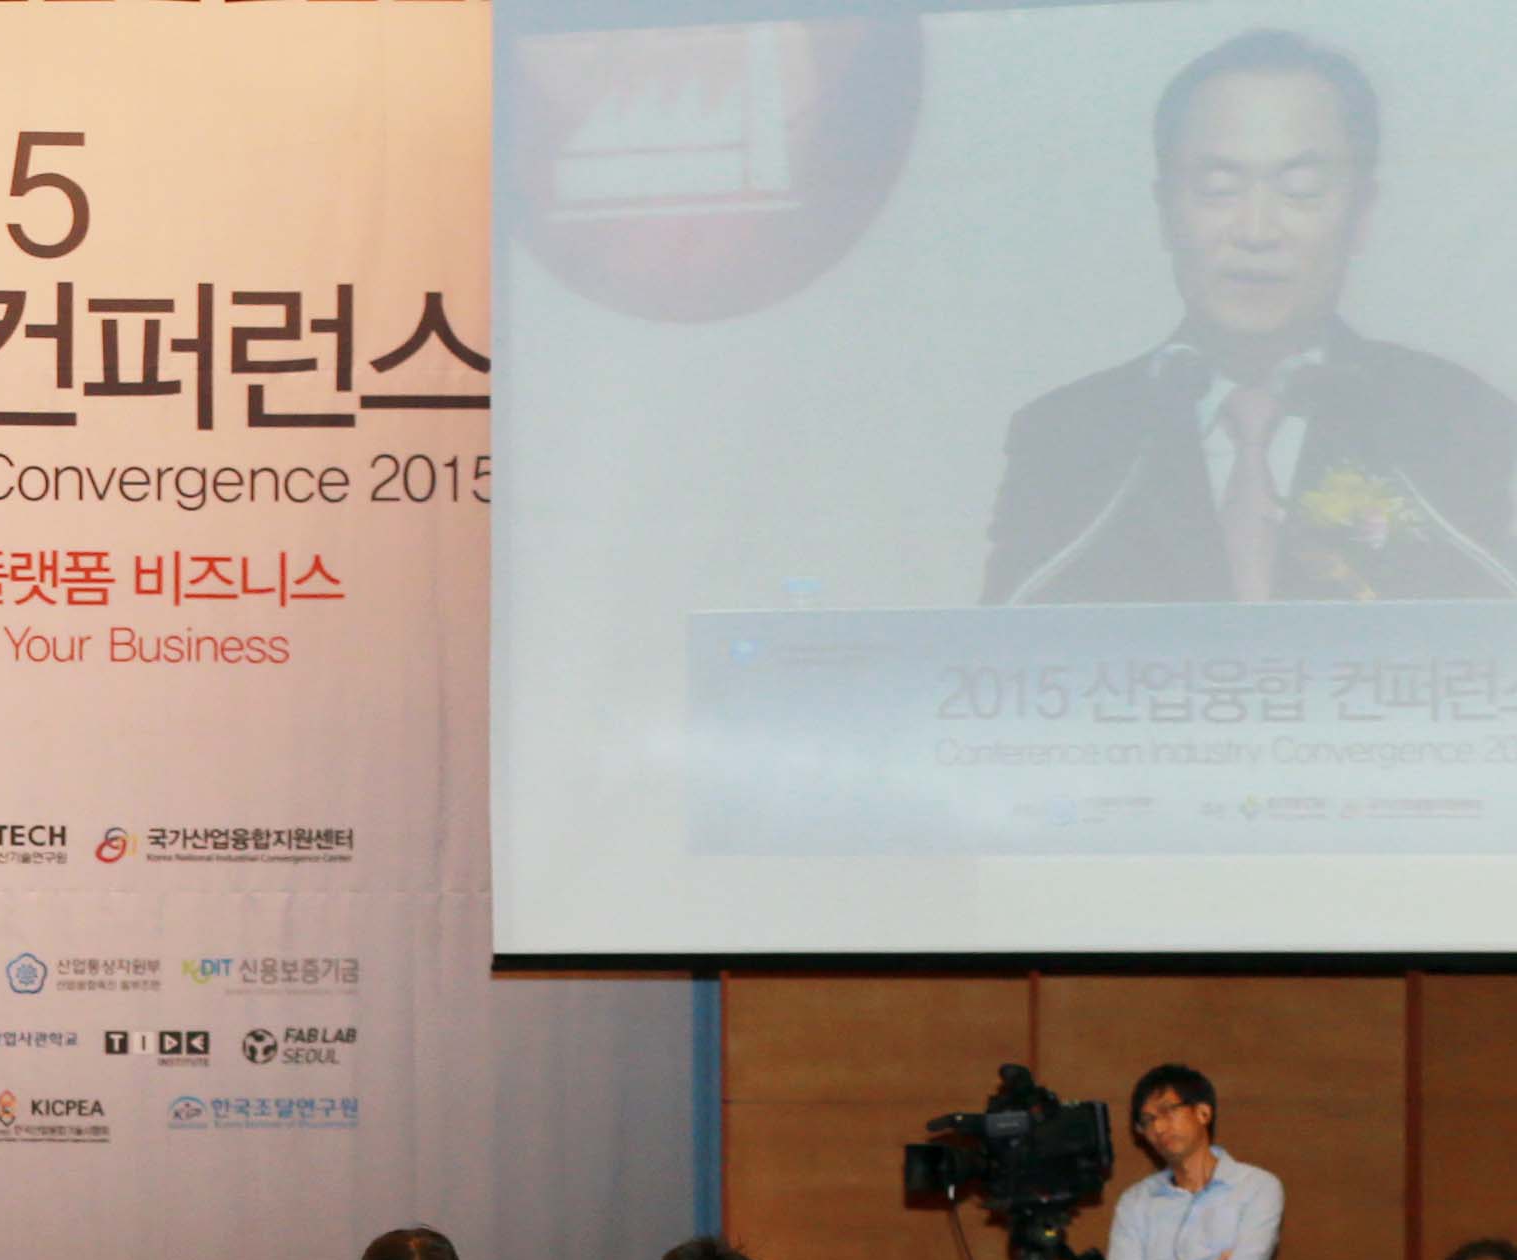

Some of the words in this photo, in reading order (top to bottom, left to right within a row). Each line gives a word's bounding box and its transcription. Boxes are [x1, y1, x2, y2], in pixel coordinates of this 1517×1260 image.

[369, 454, 491, 505] 2015
[134, 549, 346, 608] 비즈니스
[3, 627, 94, 664] Your
[110, 627, 290, 664] Business
[936, 665, 1072, 720] 2015
[1082, 659, 1313, 723] 산업융합
[1272, 734, 1475, 771] Convergence
[147, 827, 355, 851] 국가산업융합지원센터
[239, 957, 360, 984] 신용보증기금
[283, 1027, 318, 1043] FAB
[321, 1028, 357, 1044] LAB
[282, 1050, 340, 1064] SEOUL
[31, 1100, 105, 1116] KICPEA
